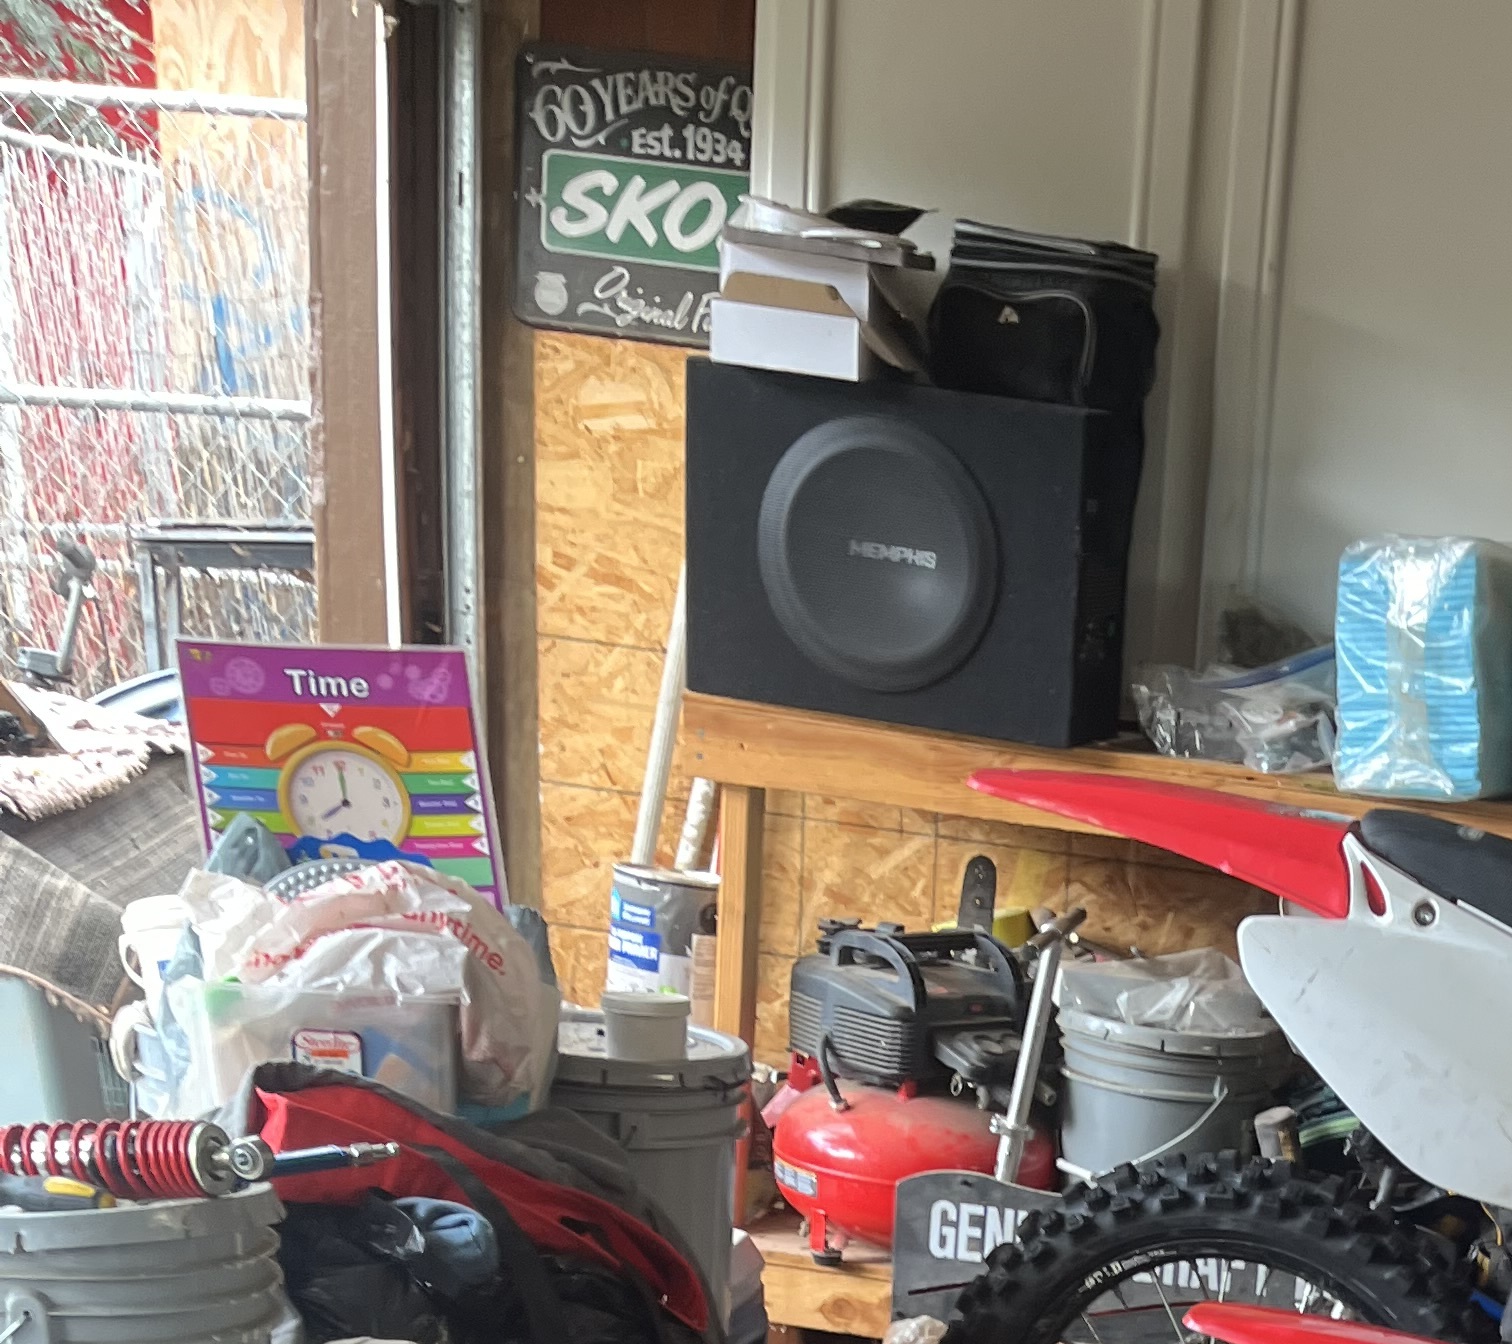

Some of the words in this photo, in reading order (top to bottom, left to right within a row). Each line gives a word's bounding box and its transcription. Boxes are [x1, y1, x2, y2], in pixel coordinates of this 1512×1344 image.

[529, 85, 596, 142] 60
[589, 69, 698, 122] YEARS
[699, 75, 735, 122] of
[550, 169, 728, 254] SKO
[577, 265, 694, 328] Original
[848, 539, 937, 570] MEMPHIS
[284, 667, 370, 699] Time
